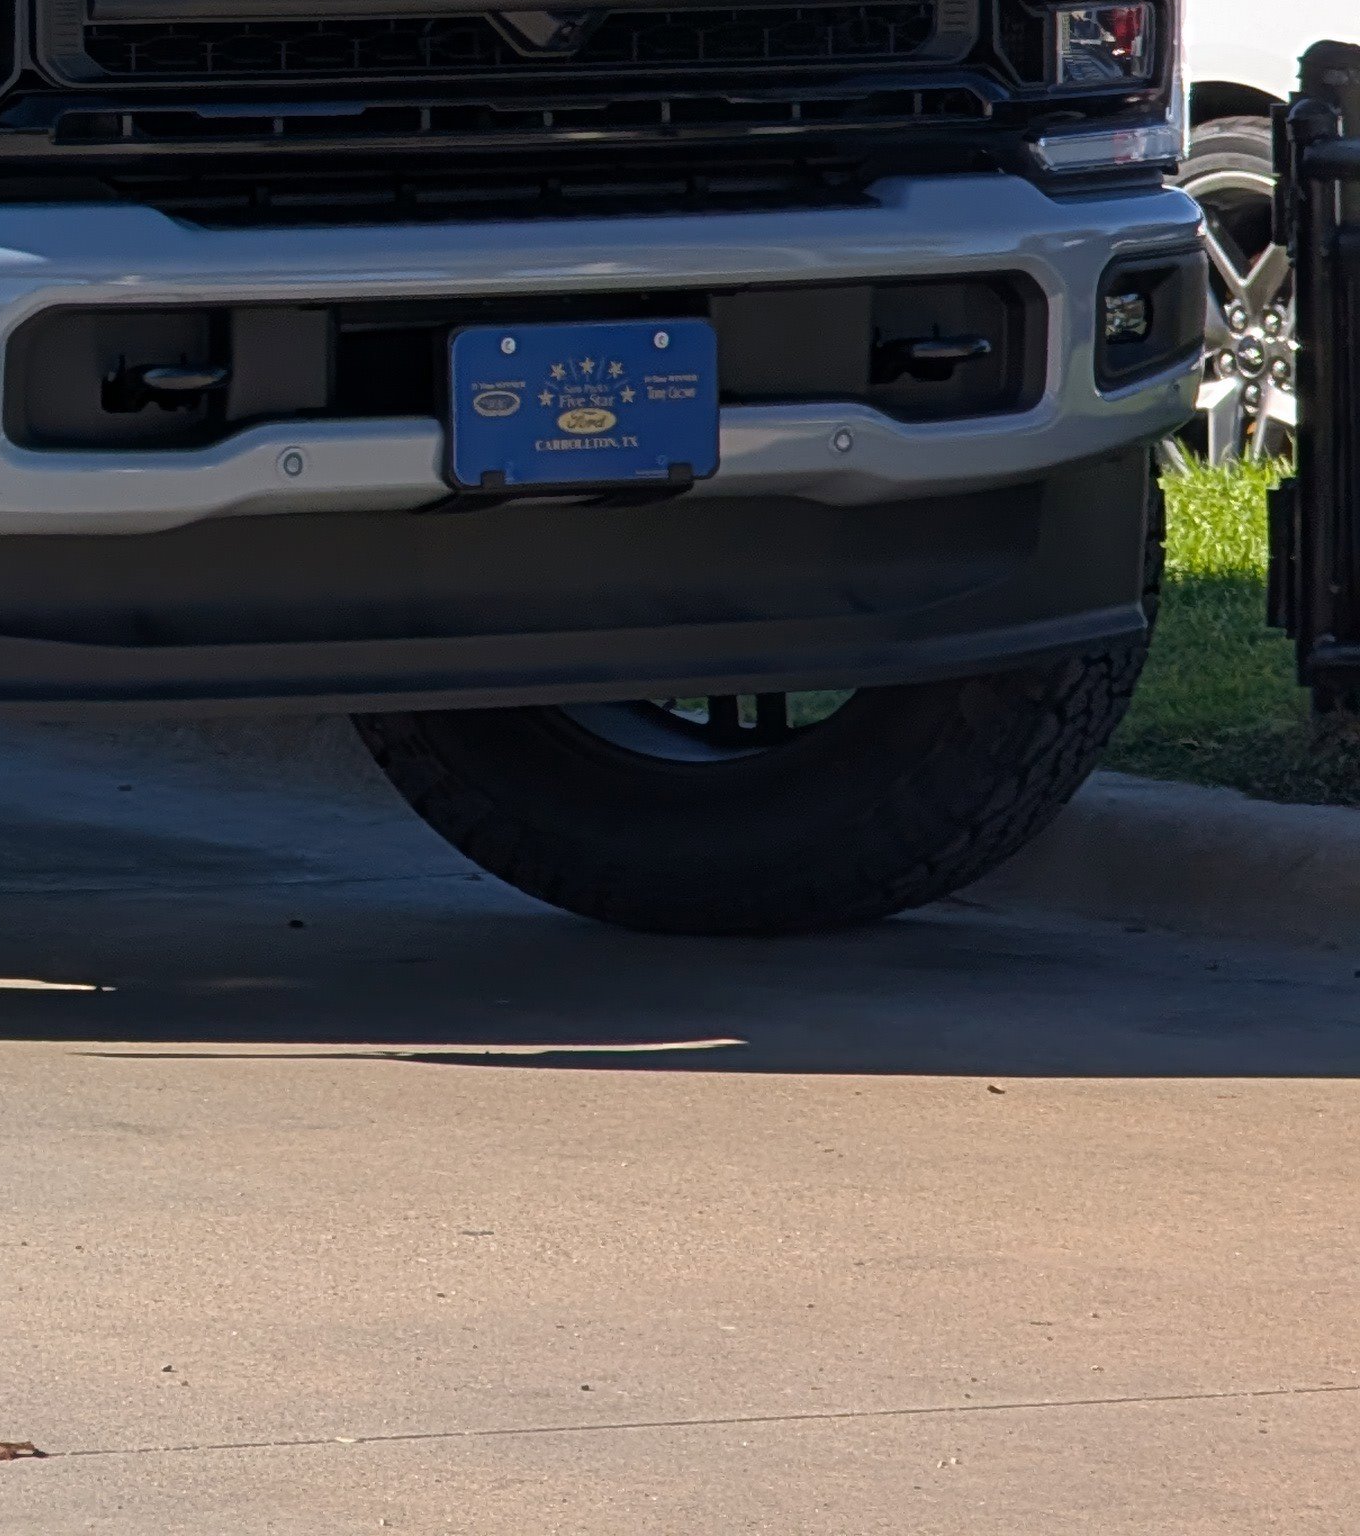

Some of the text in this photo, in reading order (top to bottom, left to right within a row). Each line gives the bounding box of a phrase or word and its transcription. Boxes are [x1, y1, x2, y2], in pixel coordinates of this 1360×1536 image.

[559, 392, 615, 409] Five Star
[622, 435, 638, 448] TX
